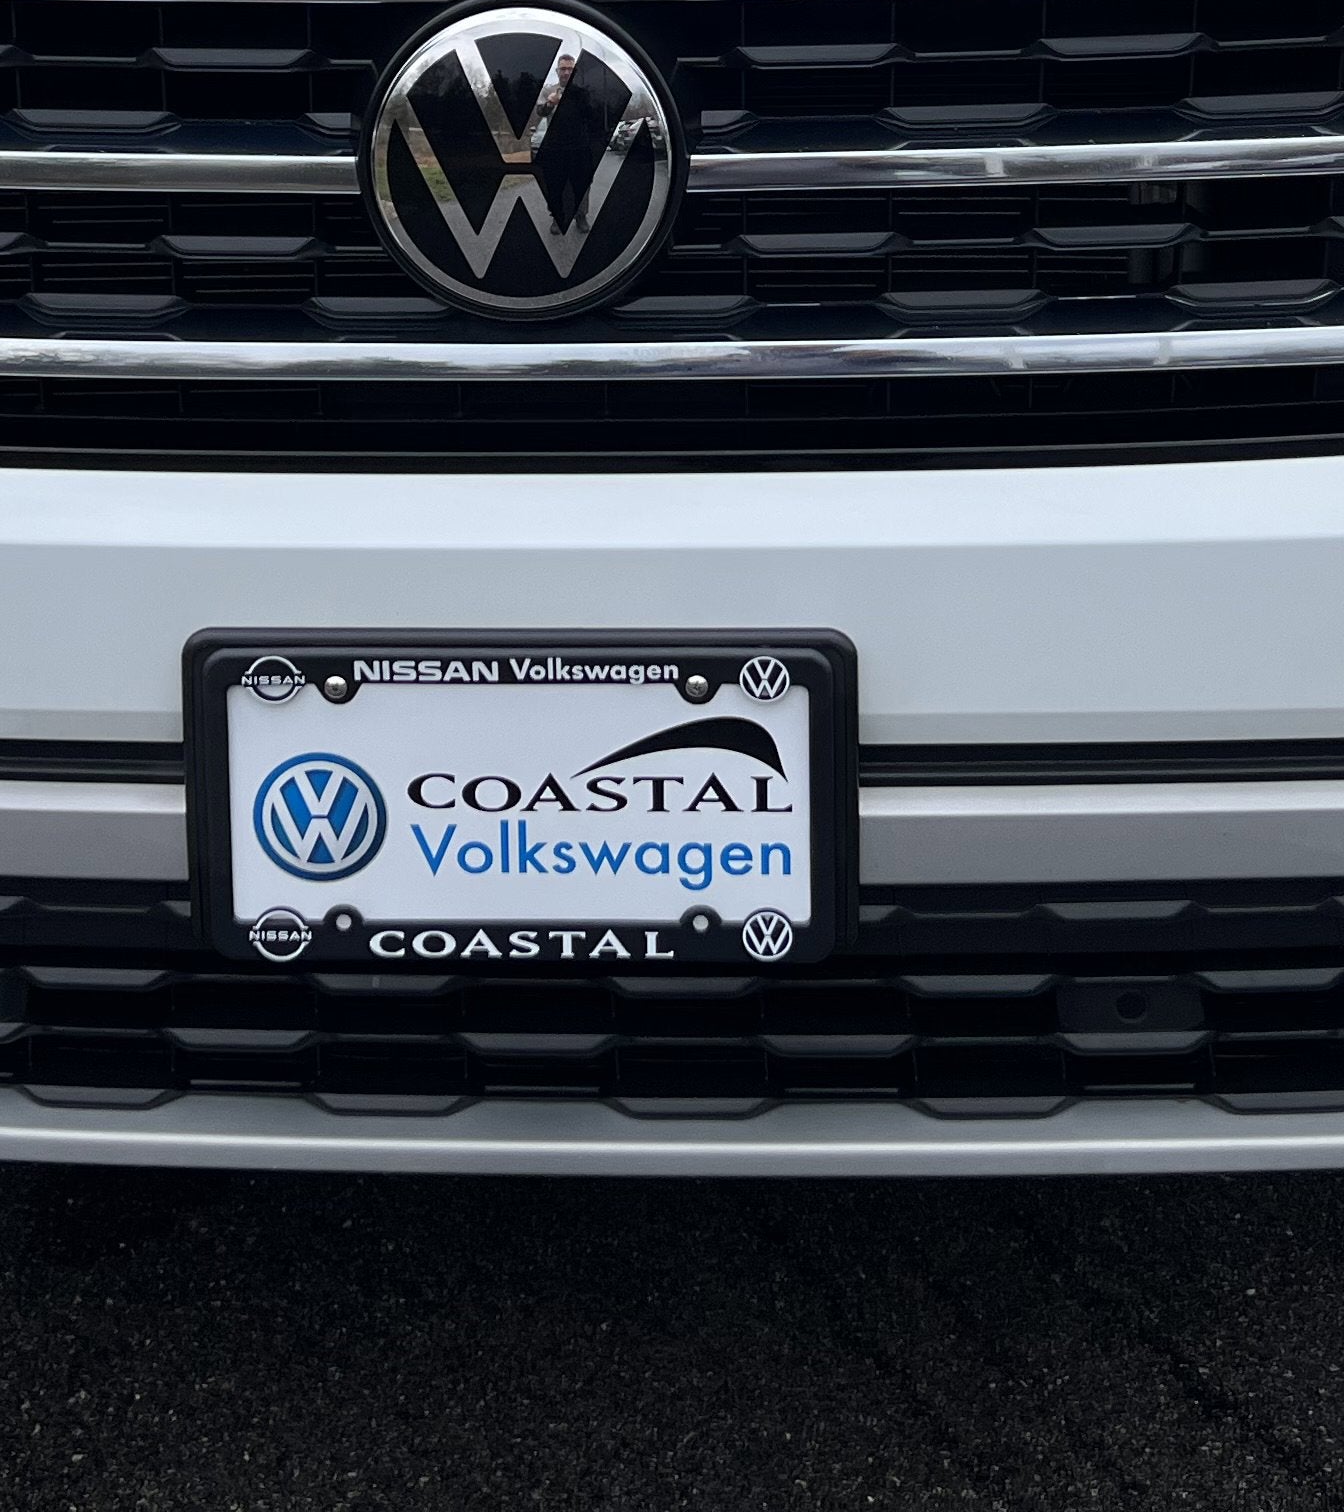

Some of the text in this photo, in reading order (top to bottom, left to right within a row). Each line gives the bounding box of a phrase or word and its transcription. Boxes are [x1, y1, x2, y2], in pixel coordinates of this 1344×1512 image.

[241, 674, 306, 686] NISSAN
[353, 657, 679, 684] NISSAN Volkswagen
[407, 771, 793, 813] COASTAL
[411, 819, 793, 892] Volkswagen
[248, 930, 312, 942] NISSAN
[369, 928, 675, 959] COASTAL
